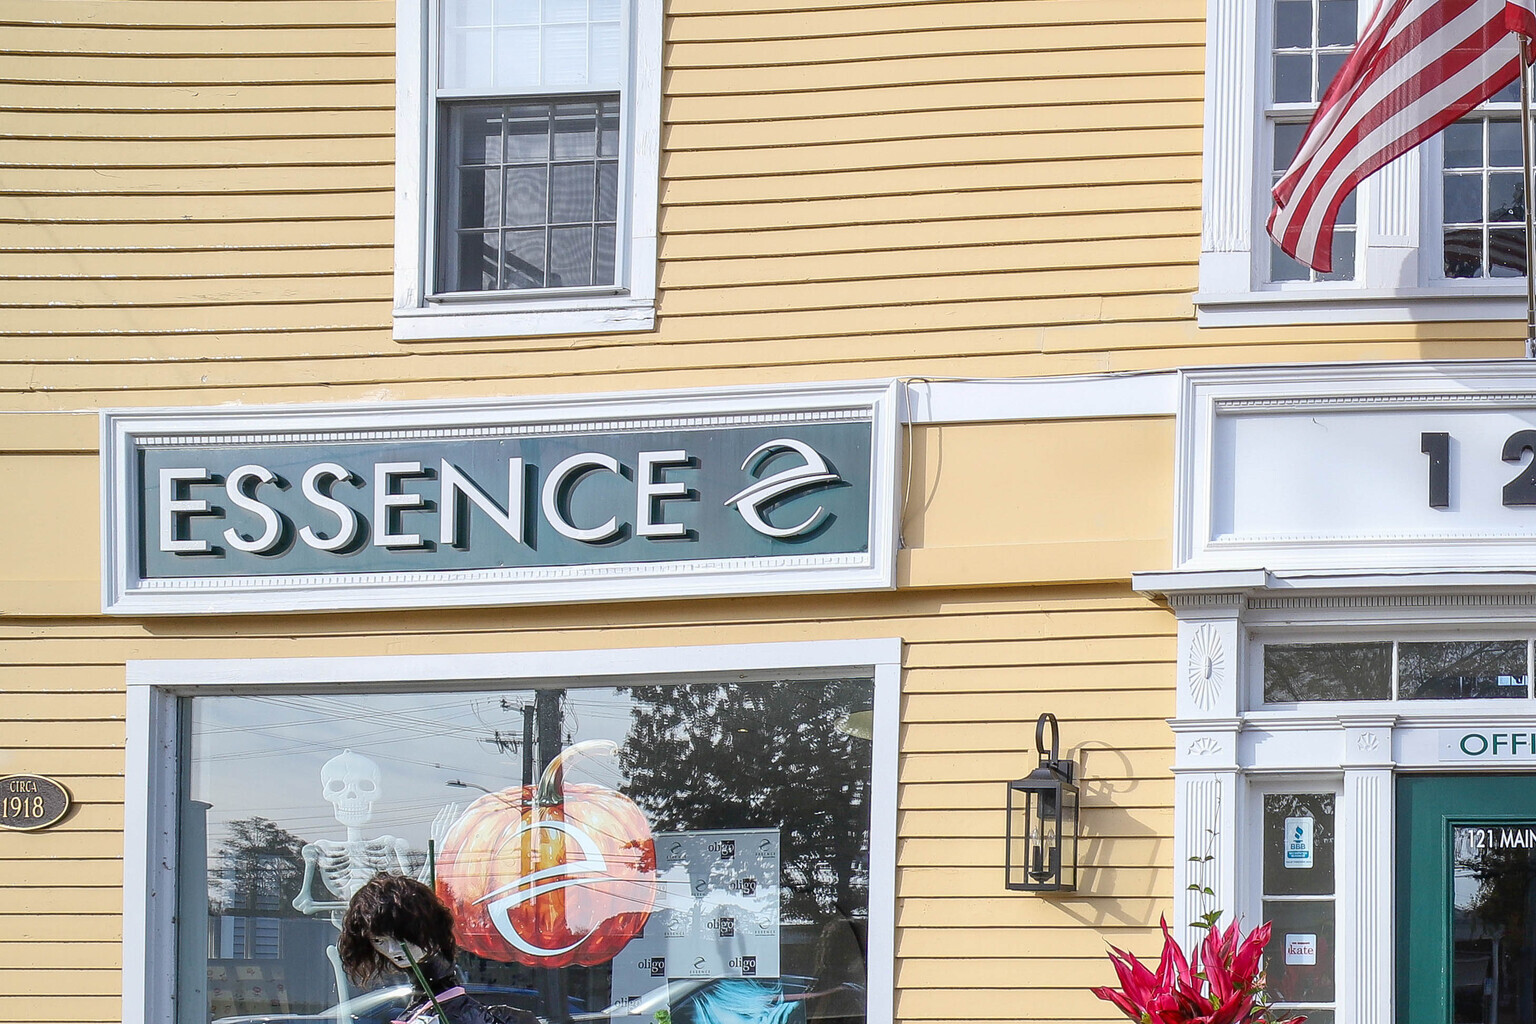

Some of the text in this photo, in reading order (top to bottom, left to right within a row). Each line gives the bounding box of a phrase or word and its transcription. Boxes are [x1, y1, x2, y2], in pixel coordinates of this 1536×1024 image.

[159, 449, 690, 552] ESSENCE
[9, 781, 38, 793] CIRCA
[2, 796, 44, 818] 1918
[1469, 829, 1493, 848] 121
[707, 841, 735, 855] oligo
[728, 879, 756, 894] oligo
[706, 918, 734, 933] oligo
[638, 957, 665, 973] oligo
[728, 957, 756, 971] oligo
